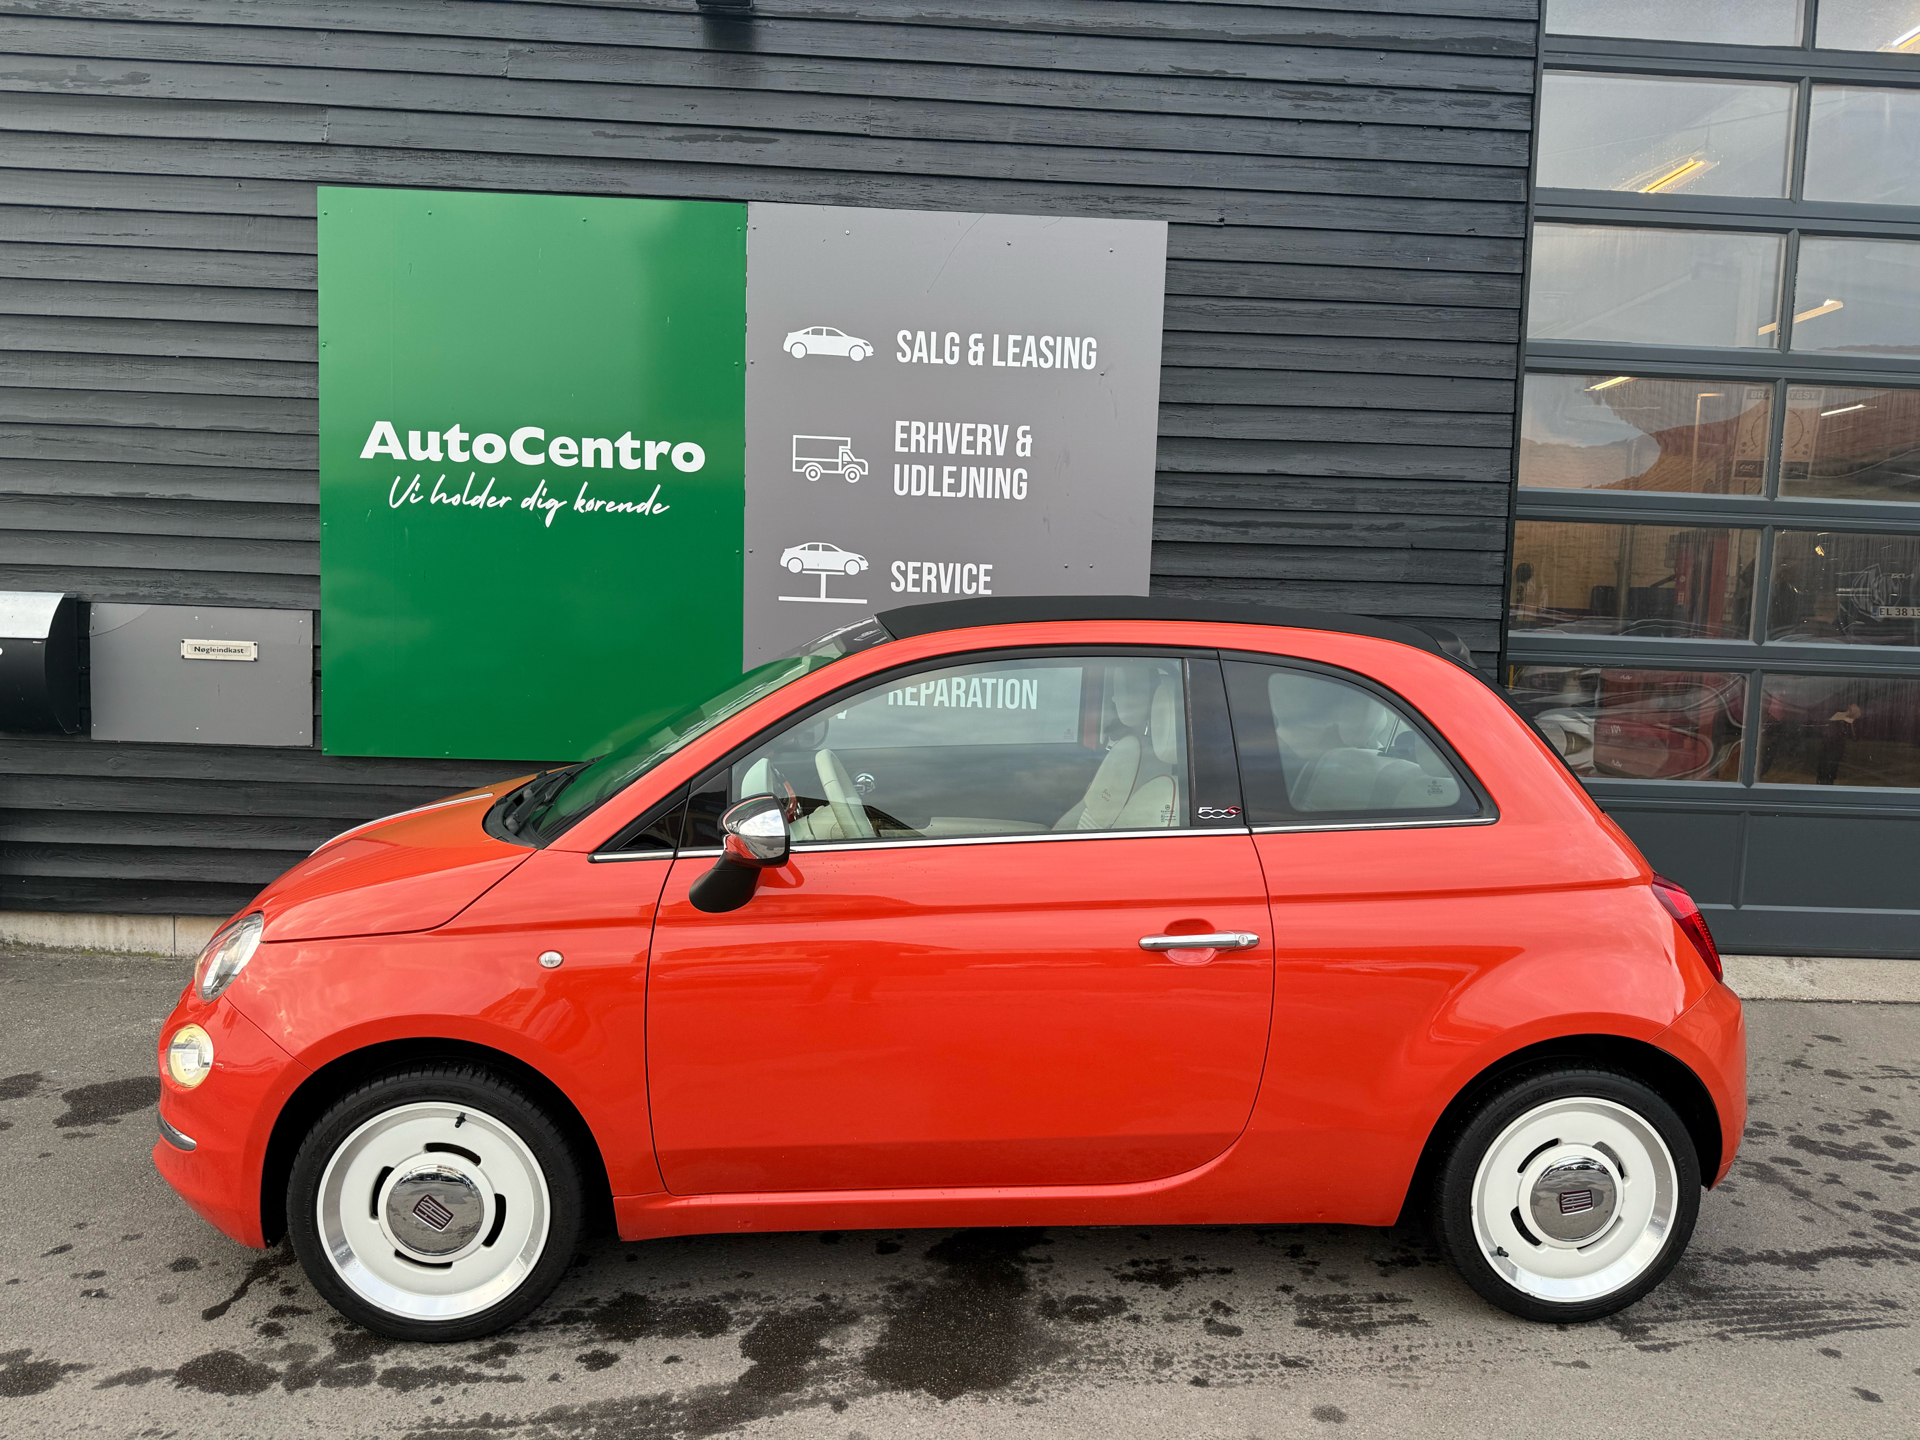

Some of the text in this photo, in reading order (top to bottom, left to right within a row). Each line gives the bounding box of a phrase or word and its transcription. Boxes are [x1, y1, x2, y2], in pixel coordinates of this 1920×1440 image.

[896, 329, 1098, 370] SALG & LEASING
[1790, 391, 1816, 399] TEST
[359, 420, 706, 473] AutoCentro
[894, 420, 1033, 458] ERHVERV &
[388, 471, 671, 528] Vi holder dig kørende
[893, 463, 1029, 500] UDLEJNING
[890, 560, 993, 595] SERVICE
[1879, 608, 1892, 616] EL
[1895, 608, 1908, 616] 38
[193, 646, 245, 654] Nøgleindkast
[887, 676, 1039, 711] REPARATION
